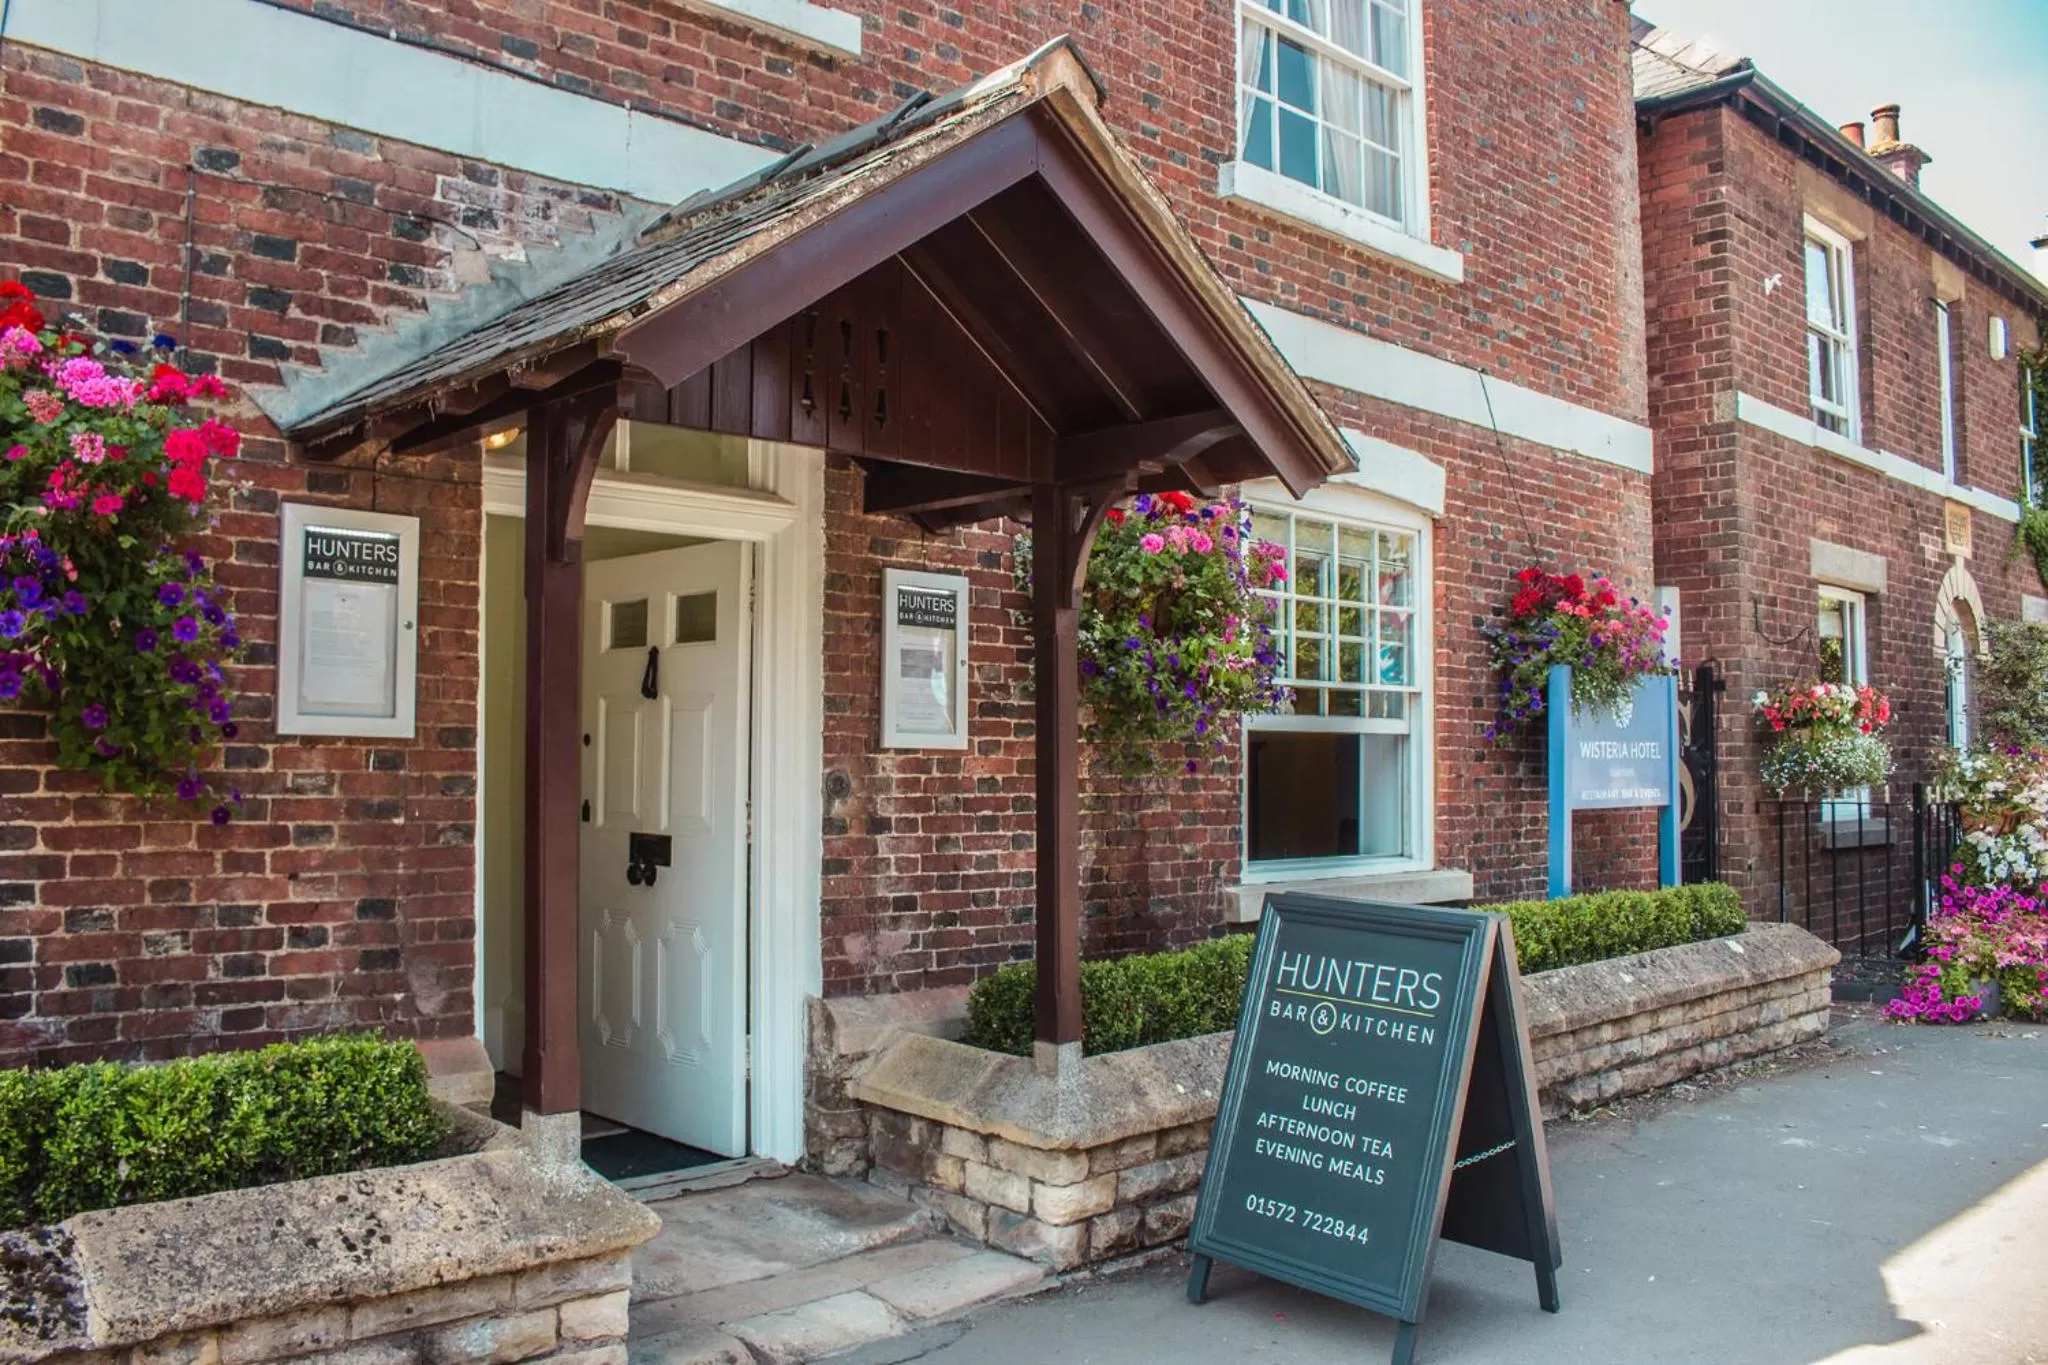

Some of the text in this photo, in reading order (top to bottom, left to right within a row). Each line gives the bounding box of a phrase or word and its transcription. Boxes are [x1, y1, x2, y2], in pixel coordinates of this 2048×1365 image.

[307, 537, 398, 562] HUNTERS
[308, 560, 330, 571] BAR
[348, 565, 397, 577] KITCHEN
[899, 594, 955, 613] HUNTERS
[1580, 740, 1662, 760] WISTERIA HOTEL
[1275, 951, 1443, 1010] HUNTERS
[1269, 1000, 1307, 1023] BAR
[1340, 1014, 1436, 1046] KITCHEN
[1265, 1060, 1408, 1104] MORNING COFFEE
[1302, 1095, 1357, 1121] LUNCH
[1256, 1112, 1393, 1159] AFTERNOON TEA
[1255, 1138, 1385, 1186] EVENING MEALS
[1246, 1194, 1370, 1246] 01572 722844
